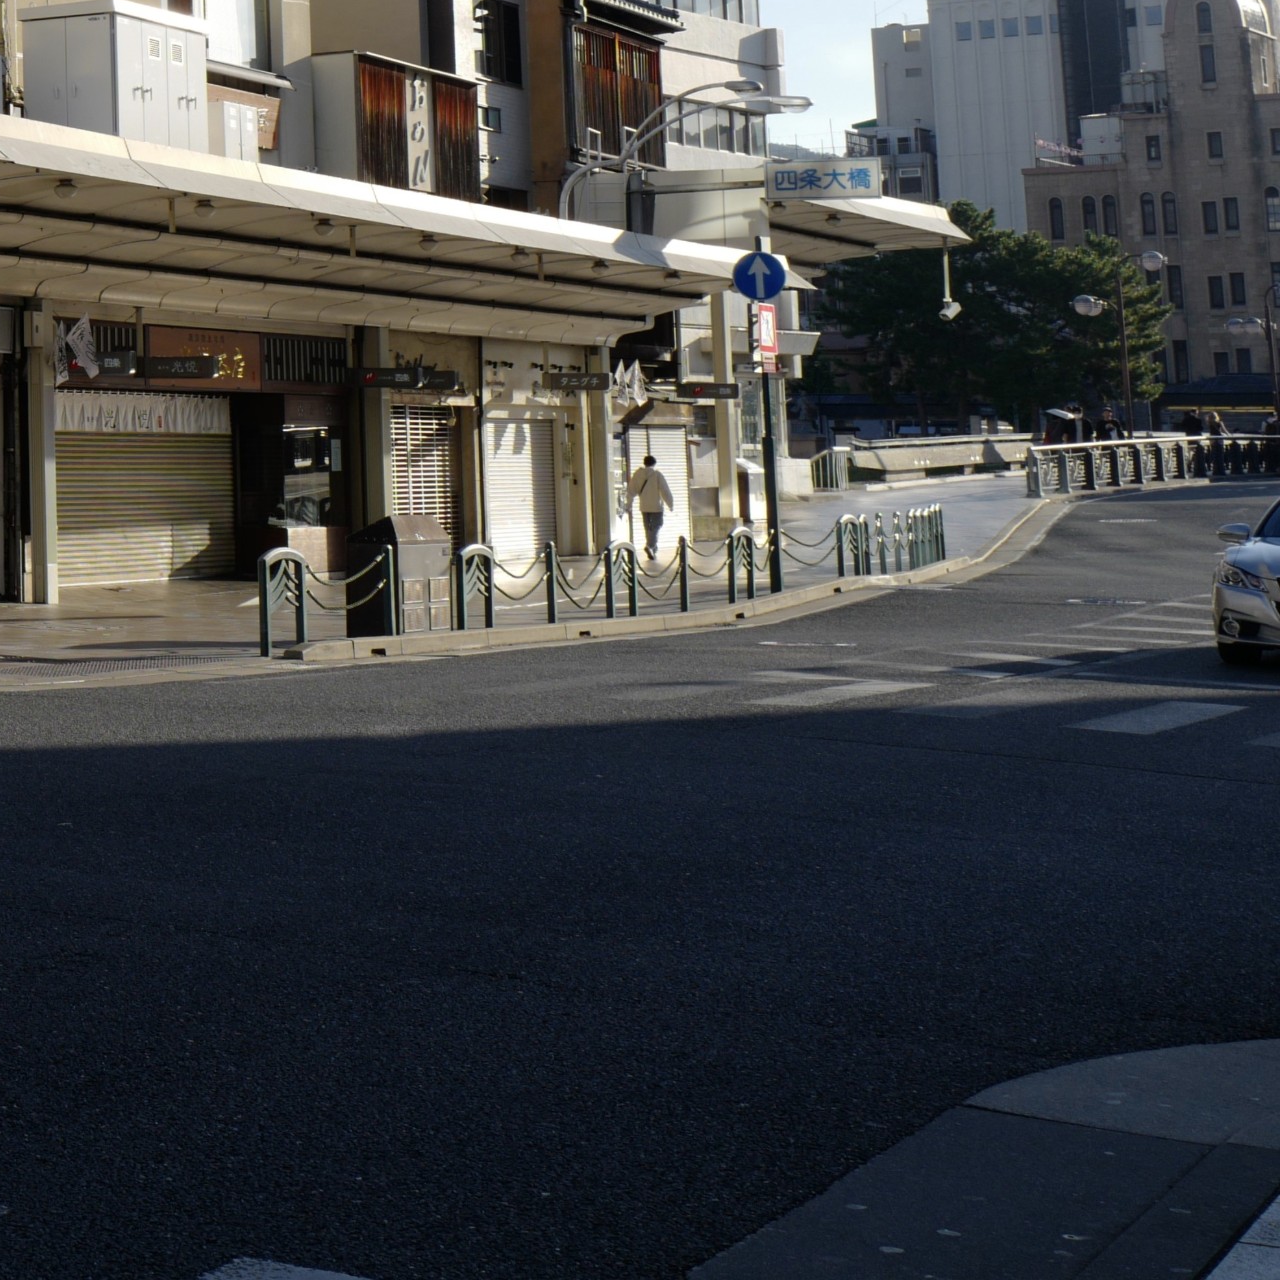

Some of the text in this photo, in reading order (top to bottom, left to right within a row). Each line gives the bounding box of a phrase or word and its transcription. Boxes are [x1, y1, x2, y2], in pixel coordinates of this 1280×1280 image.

[774, 168, 871, 191] 四条大橋
[560, 376, 600, 387] タニグチ
